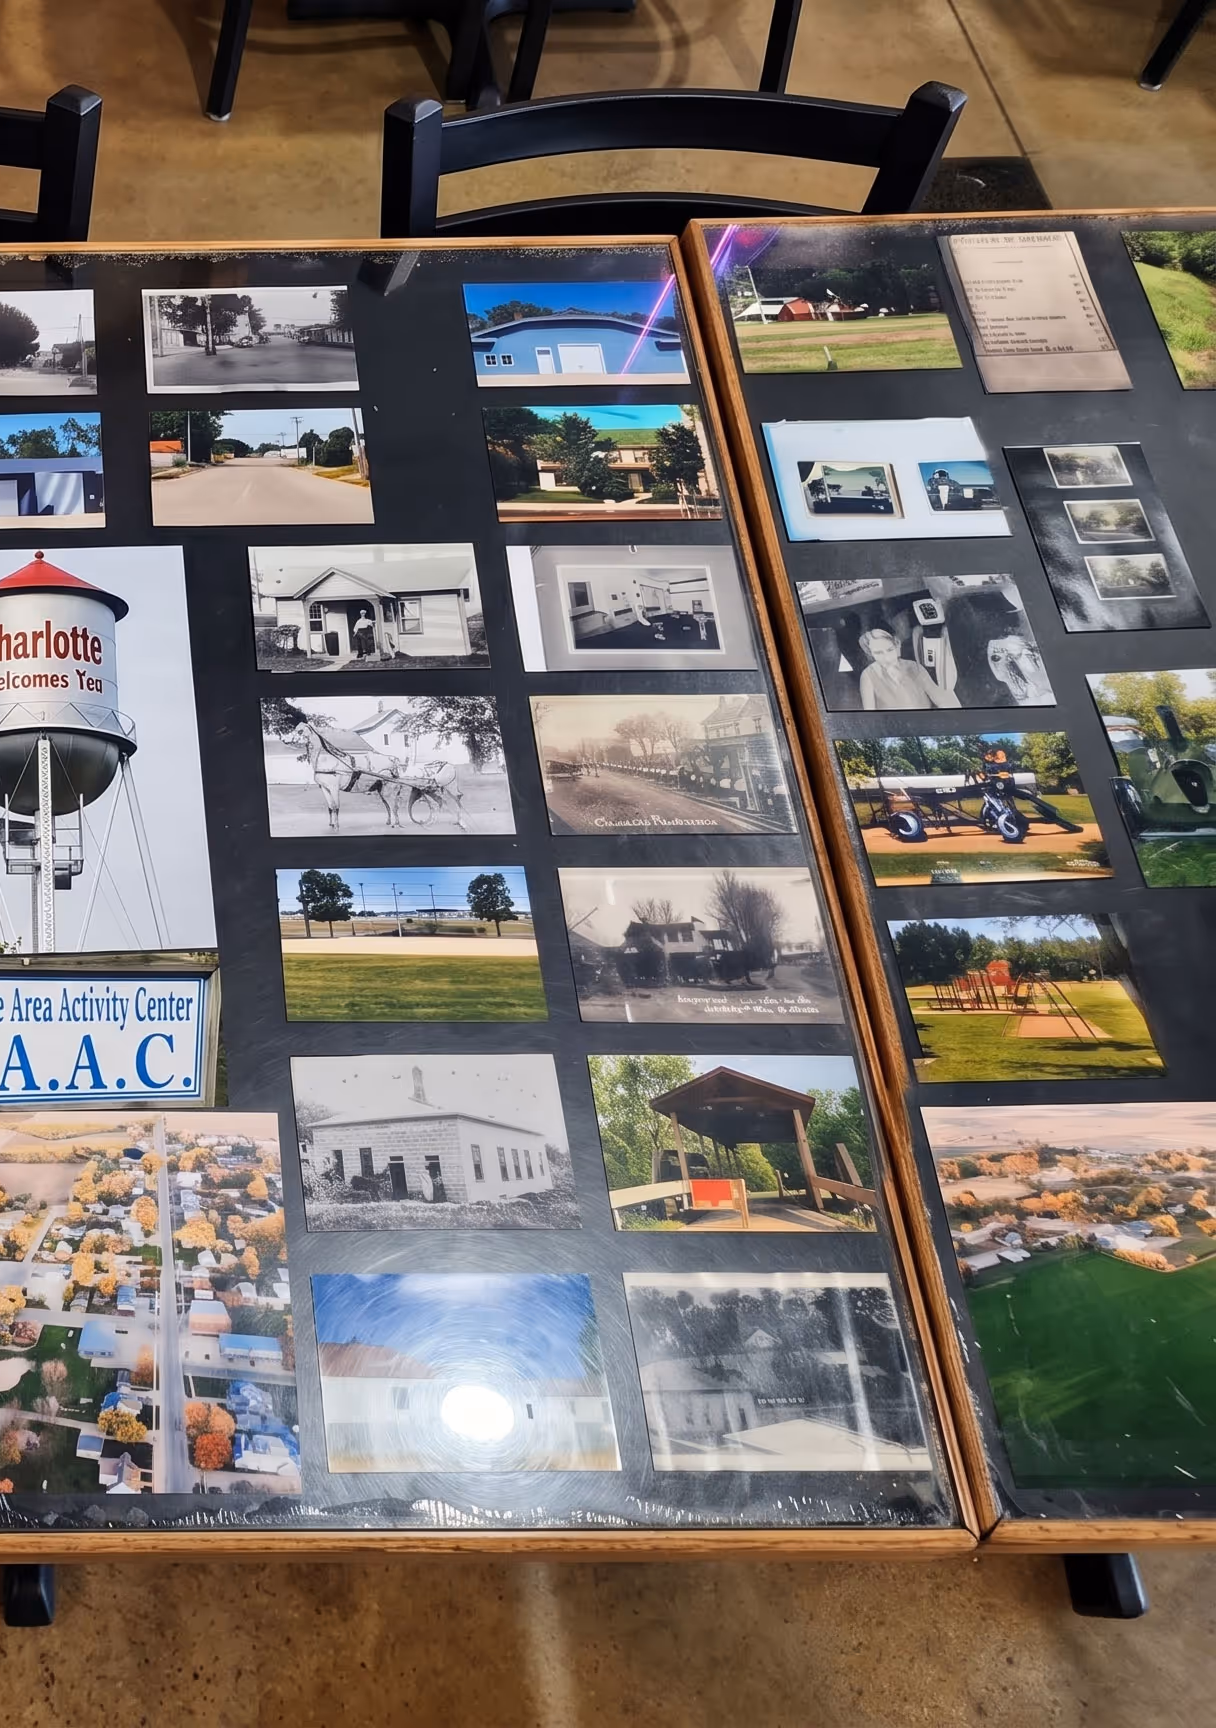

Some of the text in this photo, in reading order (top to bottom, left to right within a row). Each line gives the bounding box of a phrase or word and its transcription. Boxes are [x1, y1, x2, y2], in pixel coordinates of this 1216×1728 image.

[10, 986, 53, 1023] Area
[58, 985, 130, 1031] Activity
[134, 986, 194, 1023] Center
